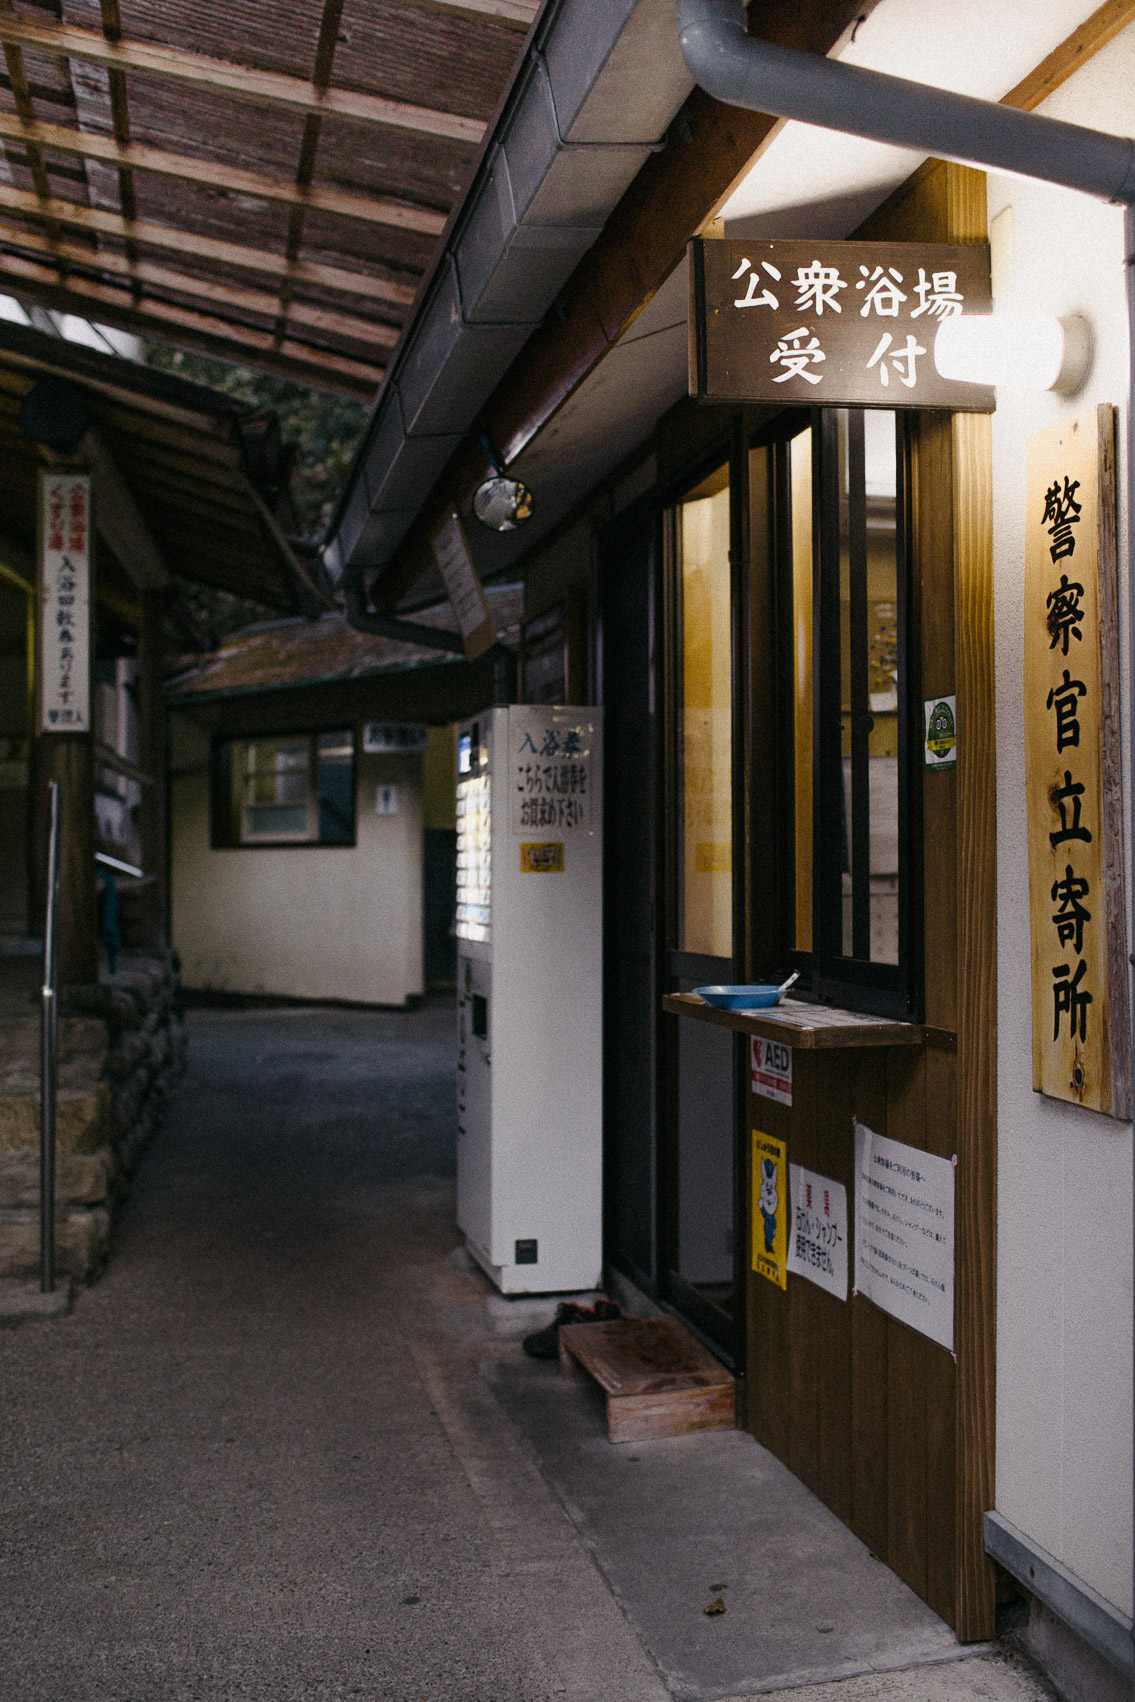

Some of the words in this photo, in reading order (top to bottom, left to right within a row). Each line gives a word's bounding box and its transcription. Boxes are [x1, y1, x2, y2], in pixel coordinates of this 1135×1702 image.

[731, 258, 964, 322] 公衆浴場
[769, 327, 927, 388] 受付
[1041, 476, 1093, 1043] 警察官立寄所
[765, 1043, 789, 1072] AED
